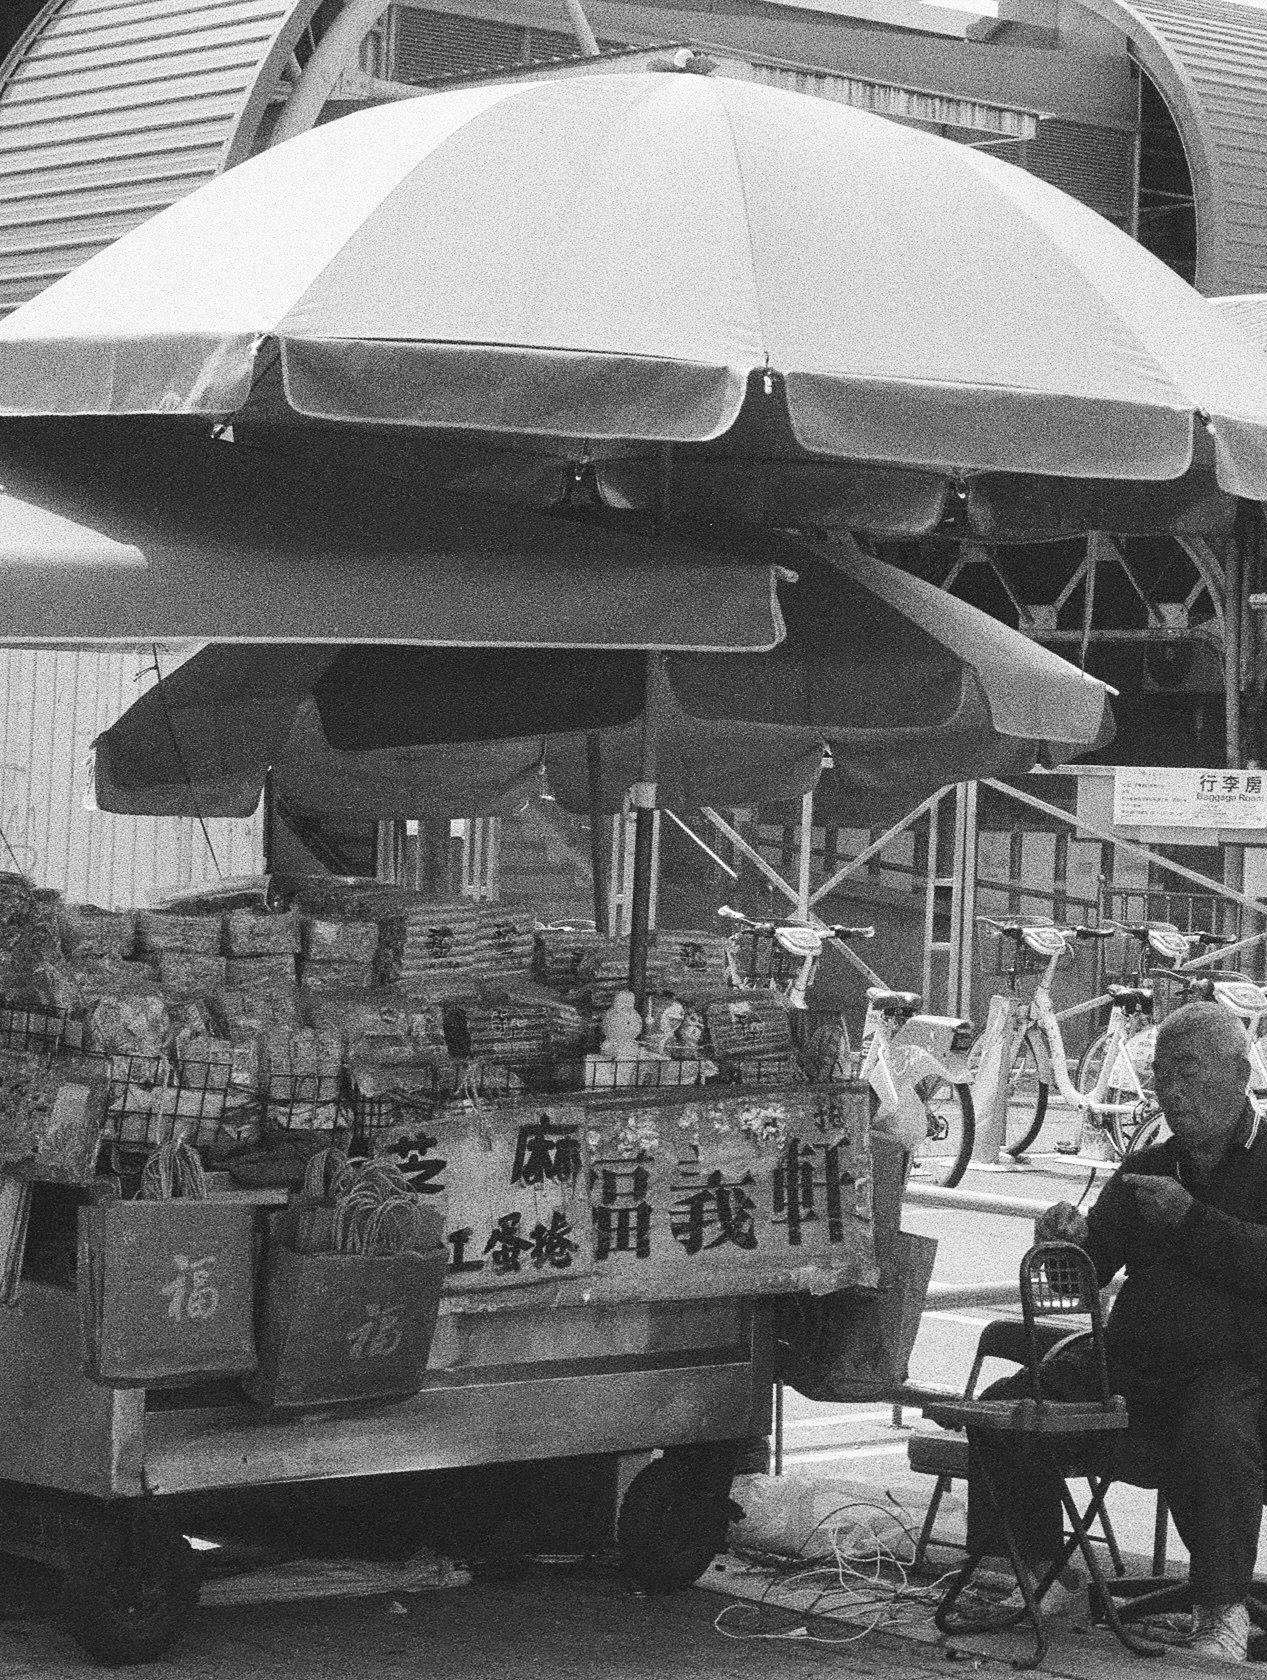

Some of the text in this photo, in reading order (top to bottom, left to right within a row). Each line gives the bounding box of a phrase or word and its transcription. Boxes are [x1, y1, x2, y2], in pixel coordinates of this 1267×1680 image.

[1197, 792, 1264, 802] Baggage Room
[1200, 774, 1262, 794] 行李房
[160, 1254, 220, 1322] 福
[346, 1303, 406, 1360] 福
